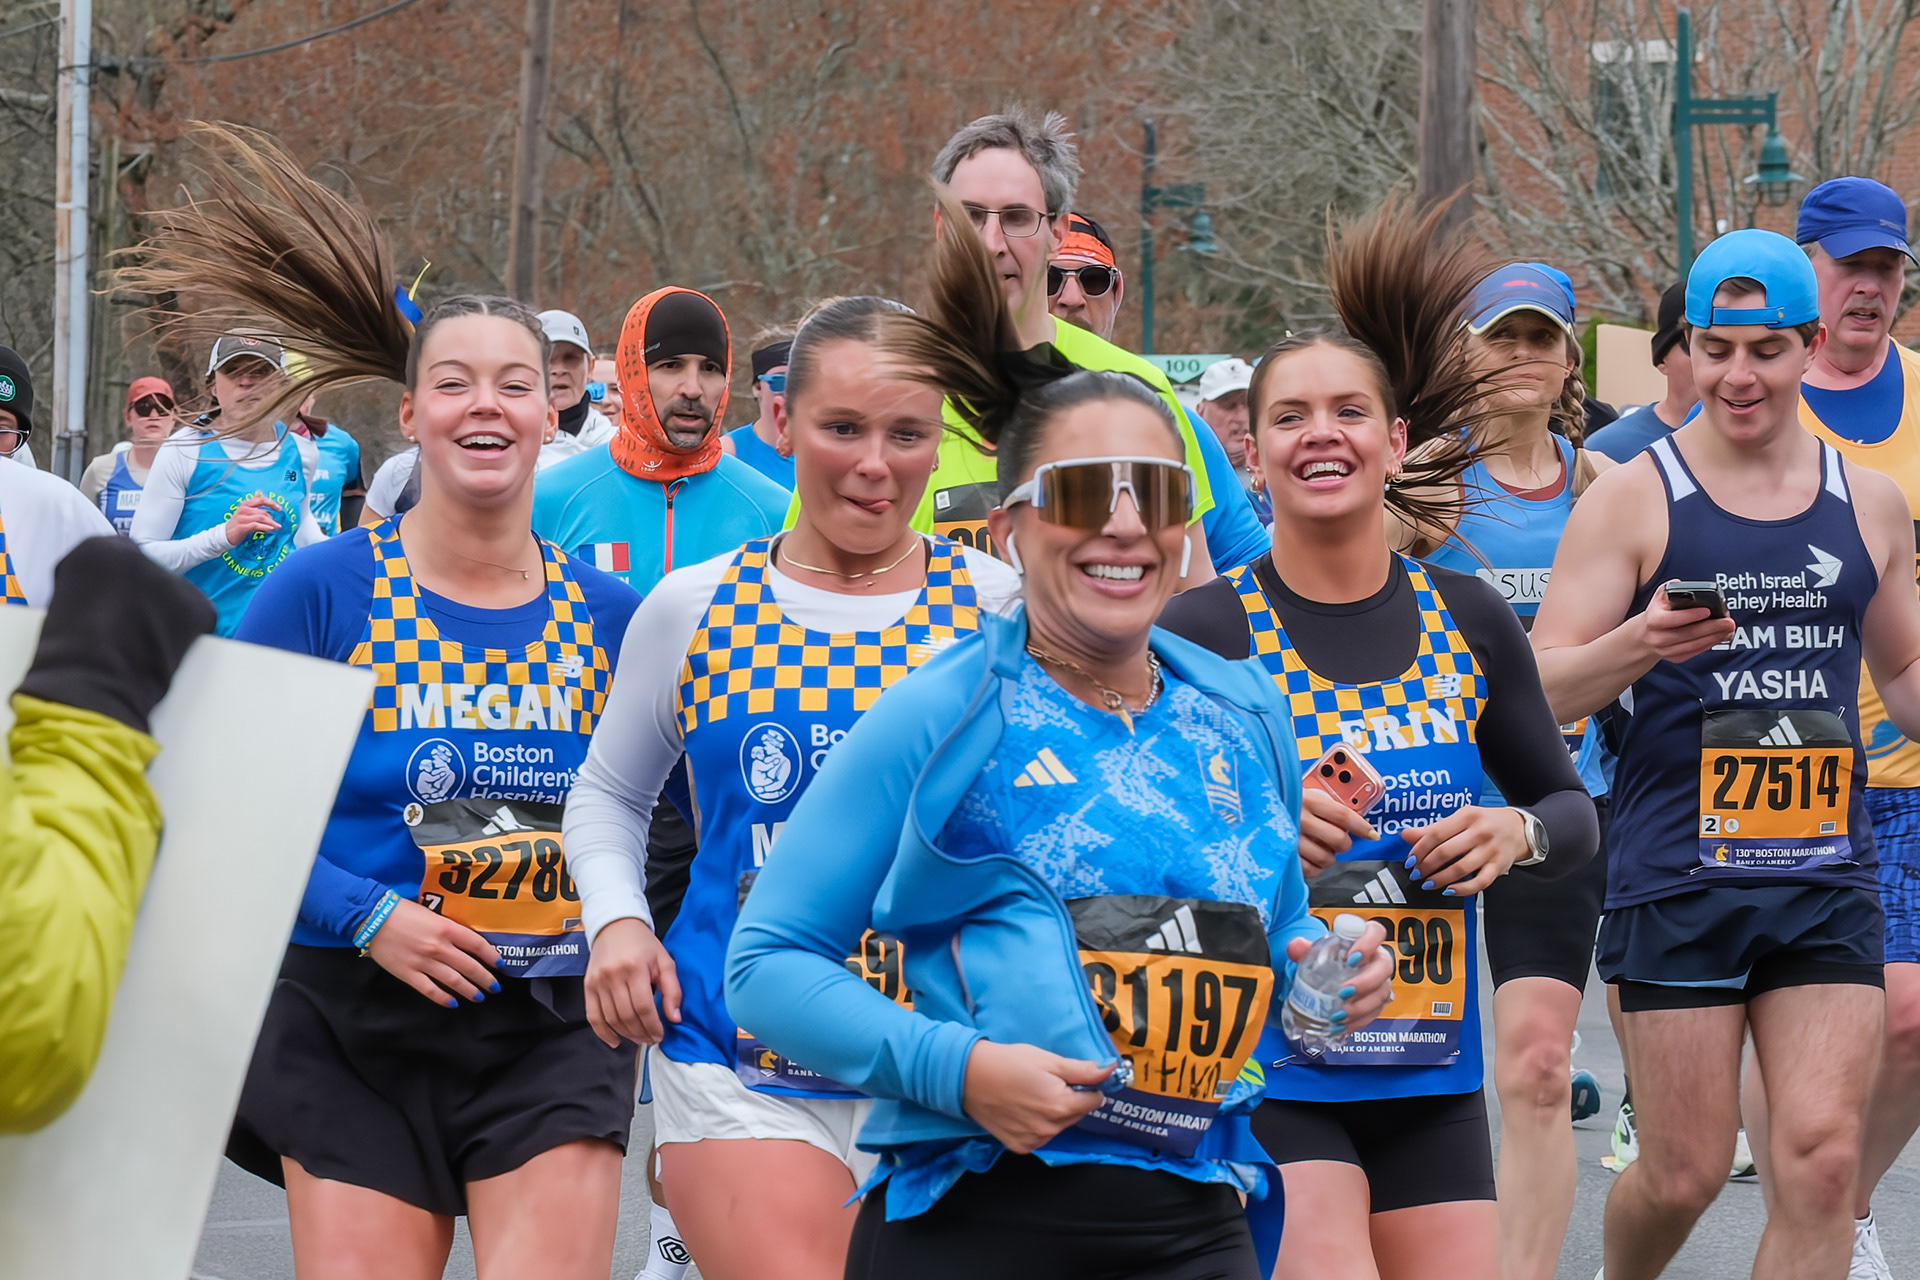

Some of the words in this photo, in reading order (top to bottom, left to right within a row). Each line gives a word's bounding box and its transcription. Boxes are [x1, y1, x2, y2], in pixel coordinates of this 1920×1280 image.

[1166, 359, 1200, 373] 100
[1715, 571, 1757, 590] Beth
[1760, 570, 1807, 589] Israel
[1726, 591, 1770, 613] ahey
[1772, 590, 1828, 609] Health
[1785, 625, 1845, 649] BILH
[1712, 669, 1829, 701] YASHA
[400, 682, 574, 732] MEGAN
[1336, 706, 1461, 755] ERIN
[473, 741, 554, 764] Boston
[472, 764, 579, 788] Children's
[1382, 768, 1452, 791] oston
[1712, 755, 1840, 811] 27514
[1704, 817, 1718, 832] 2
[1755, 848, 1790, 858] BOSTON
[1792, 845, 1836, 857] MARATHON
[1354, 1031, 1397, 1043] BOSTON
[1398, 1031, 1447, 1044] MARATHON
[1355, 1045, 1367, 1053] OF
[1368, 1045, 1406, 1053] AMERICA
[1112, 1099, 1166, 1124] BOSTON
